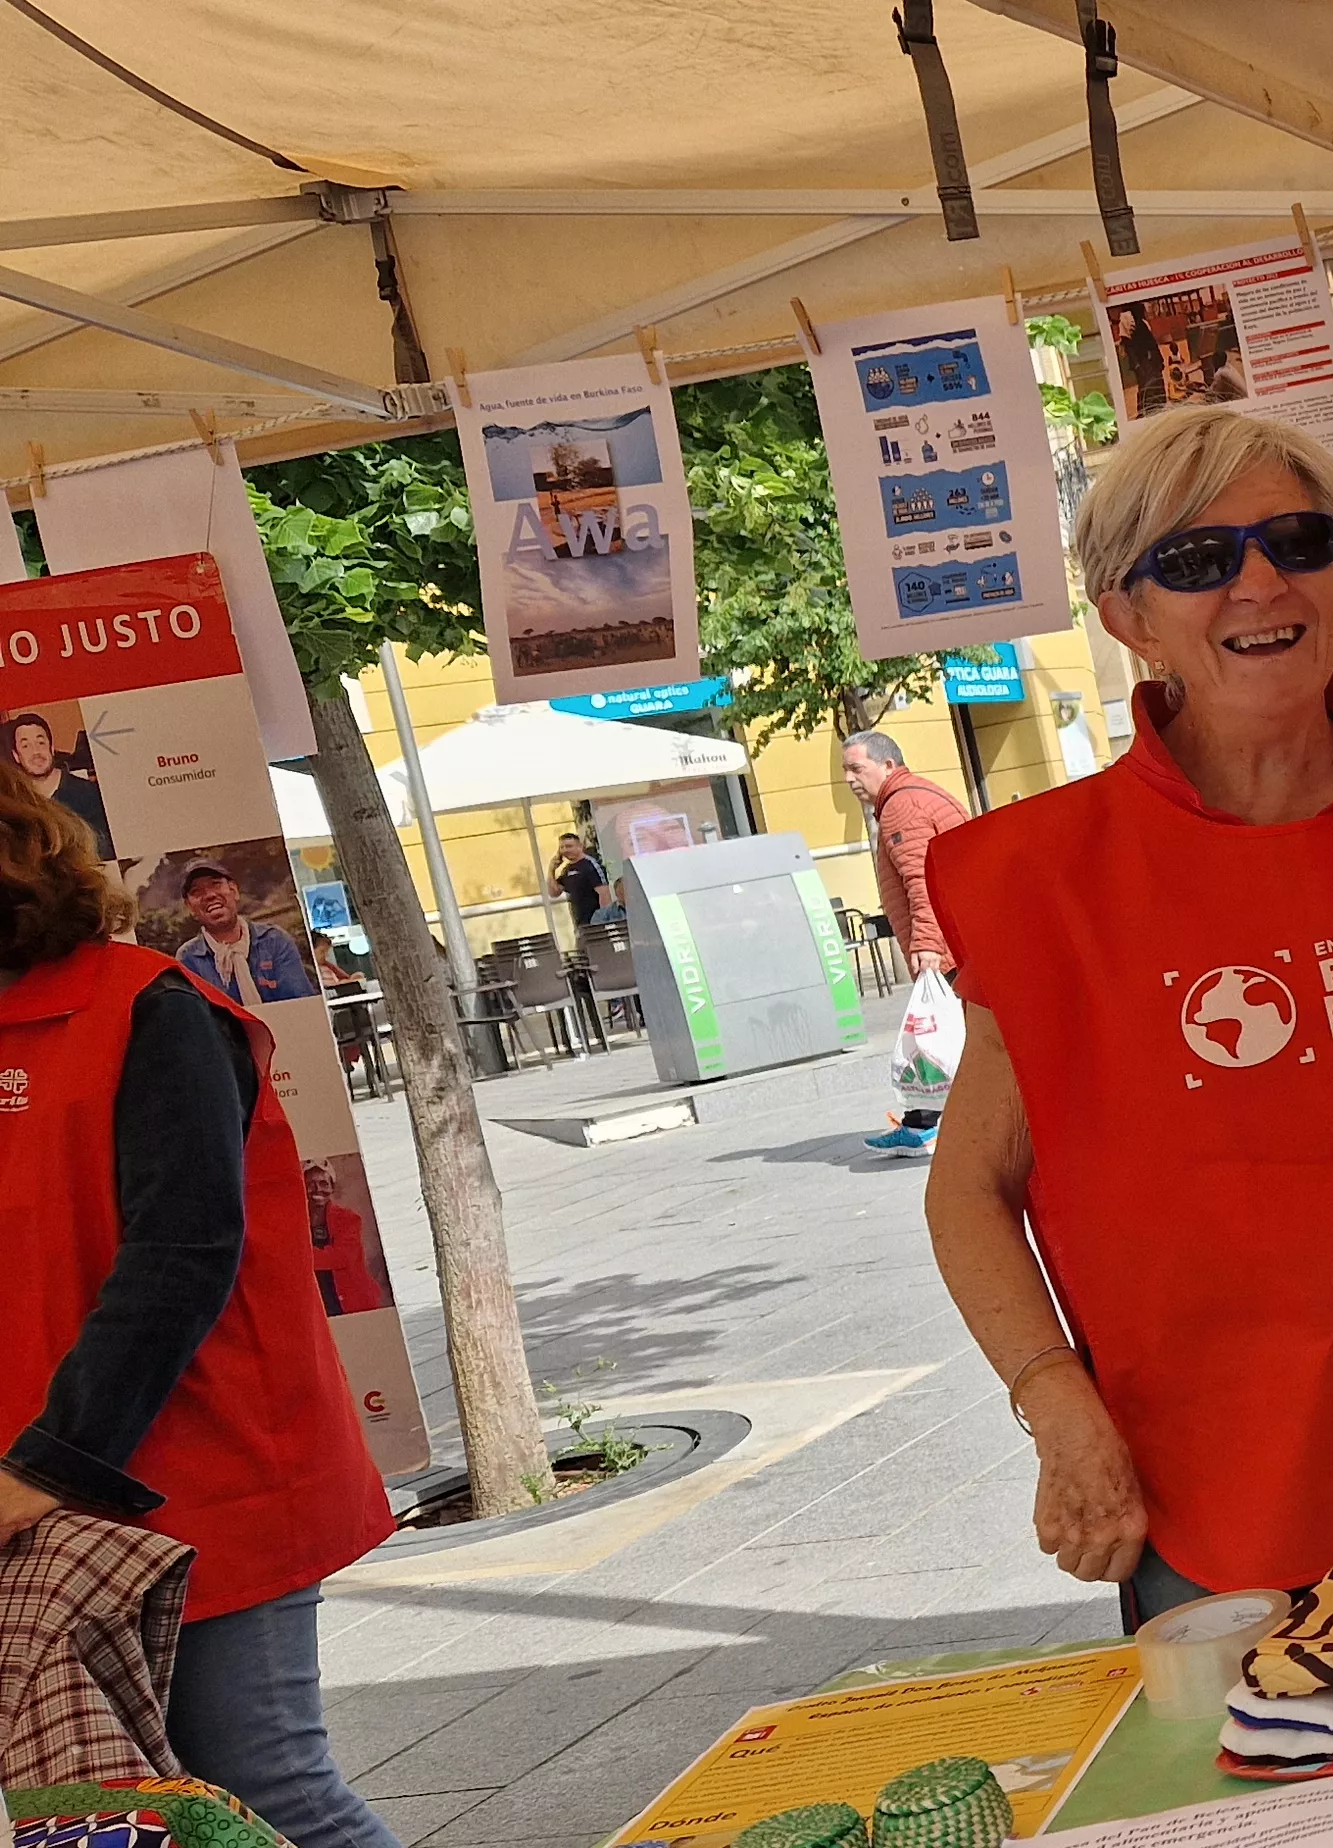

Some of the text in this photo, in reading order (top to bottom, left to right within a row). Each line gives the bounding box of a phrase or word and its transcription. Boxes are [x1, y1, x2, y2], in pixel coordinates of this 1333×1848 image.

[479, 385, 644, 413] Agua, fuente de vida en Burkina Faso
[506, 503, 668, 564] Awa
[60, 604, 201, 658] JUSTO
[981, 666, 1019, 681] GUARA
[607, 687, 651, 704] natural
[629, 699, 674, 714] GUARA
[157, 752, 199, 768] Bruno
[148, 768, 217, 787] Consumidor
[811, 894, 848, 985] VIDRIO
[729, 1743, 783, 1759] Qué
[648, 1811, 737, 1832] Dónde
[1096, 1831, 1122, 1843] del
[1128, 1823, 1160, 1836] Pan
[1166, 1817, 1188, 1827] de
